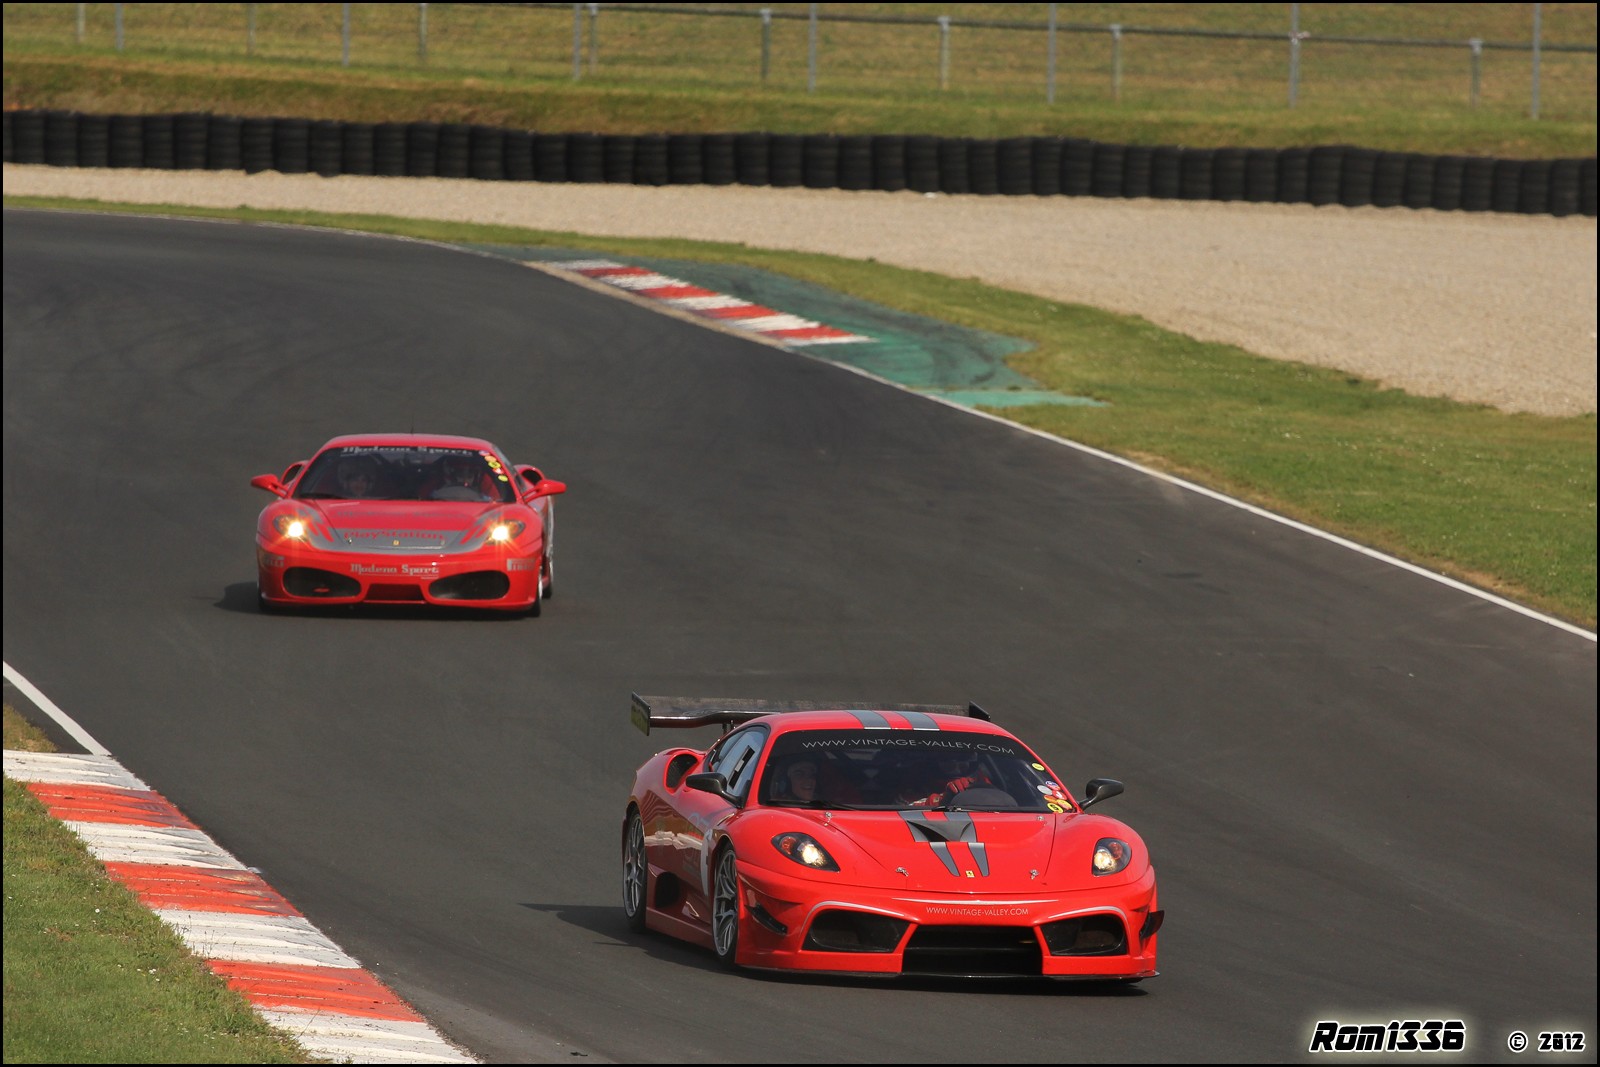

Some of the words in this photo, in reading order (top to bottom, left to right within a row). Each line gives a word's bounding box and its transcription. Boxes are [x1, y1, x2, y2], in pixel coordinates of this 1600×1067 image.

[350, 563, 397, 575] Modena
[401, 564, 440, 576] Sport
[802, 737, 1015, 756] WWW.VINTAGE-VALLEY.COM
[926, 906, 1029, 917] WWW.VINTAGE-VALLEY.COM
